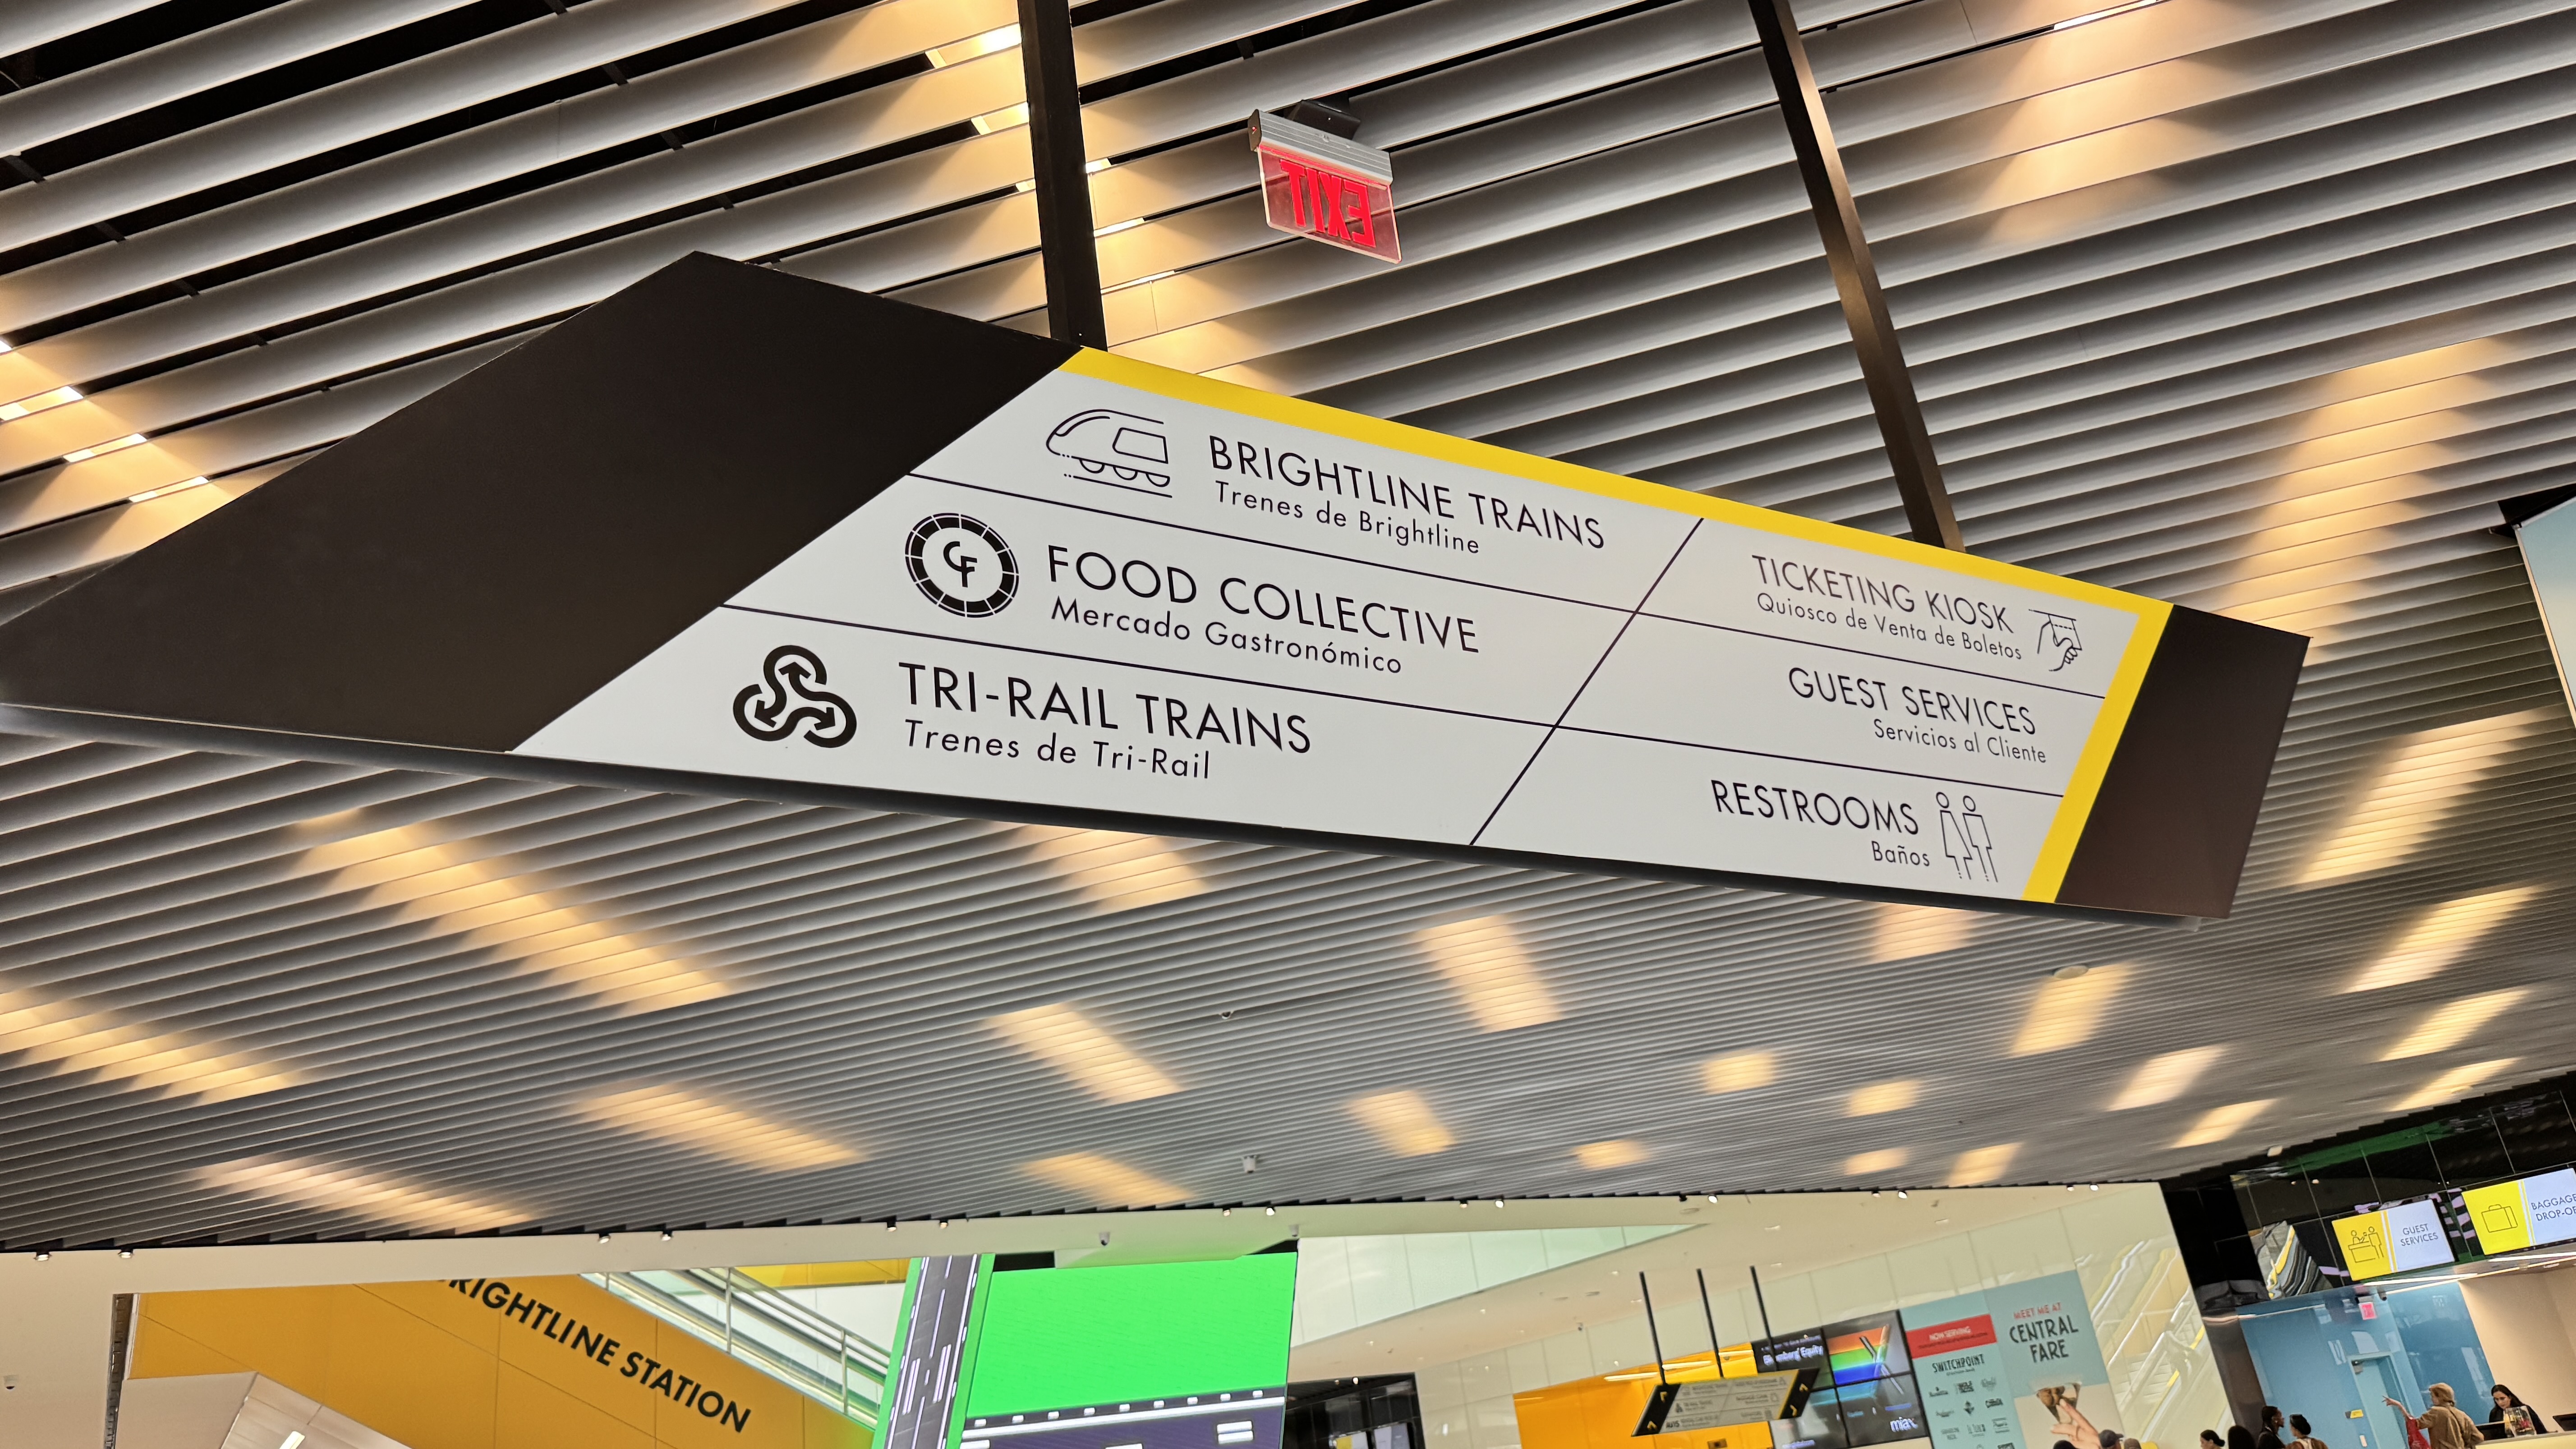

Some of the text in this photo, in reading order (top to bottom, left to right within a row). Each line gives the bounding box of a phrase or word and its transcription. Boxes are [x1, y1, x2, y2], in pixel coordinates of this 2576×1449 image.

[1210, 436, 1604, 548] BRIGHTLINE TRAINS
[1215, 480, 1478, 553] Trenes de Brightline
[1049, 545, 1478, 653] FOOD COLLECTIVE
[1752, 555, 2013, 633] TICKETING KIOSK
[1052, 596, 1401, 673] Mercado Gastronómico
[1758, 593, 2021, 659] Quiosco de Venta de Boletos
[899, 662, 1310, 753] TRI-RAIL TRAINS
[1789, 667, 2035, 734] GUEST SERVICES
[906, 719, 1209, 778] Trenes de Tri-Rail
[1874, 719, 2046, 763] Servicios al Cliente
[1711, 780, 1918, 835] RESTROOMS
[1872, 841, 1929, 866] Baños
[2403, 1223, 2429, 1235] GUEST
[2531, 1193, 2576, 1210] BAGGAGE
[2400, 1232, 2438, 1246] SERVICES
[2009, 1315, 2079, 1343] CENTRAL
[2014, 1302, 2062, 1320] MEET ME AT
[437, 1279, 751, 1433] IGHTLINE STATION
[2030, 1339, 2069, 1363] FARE
